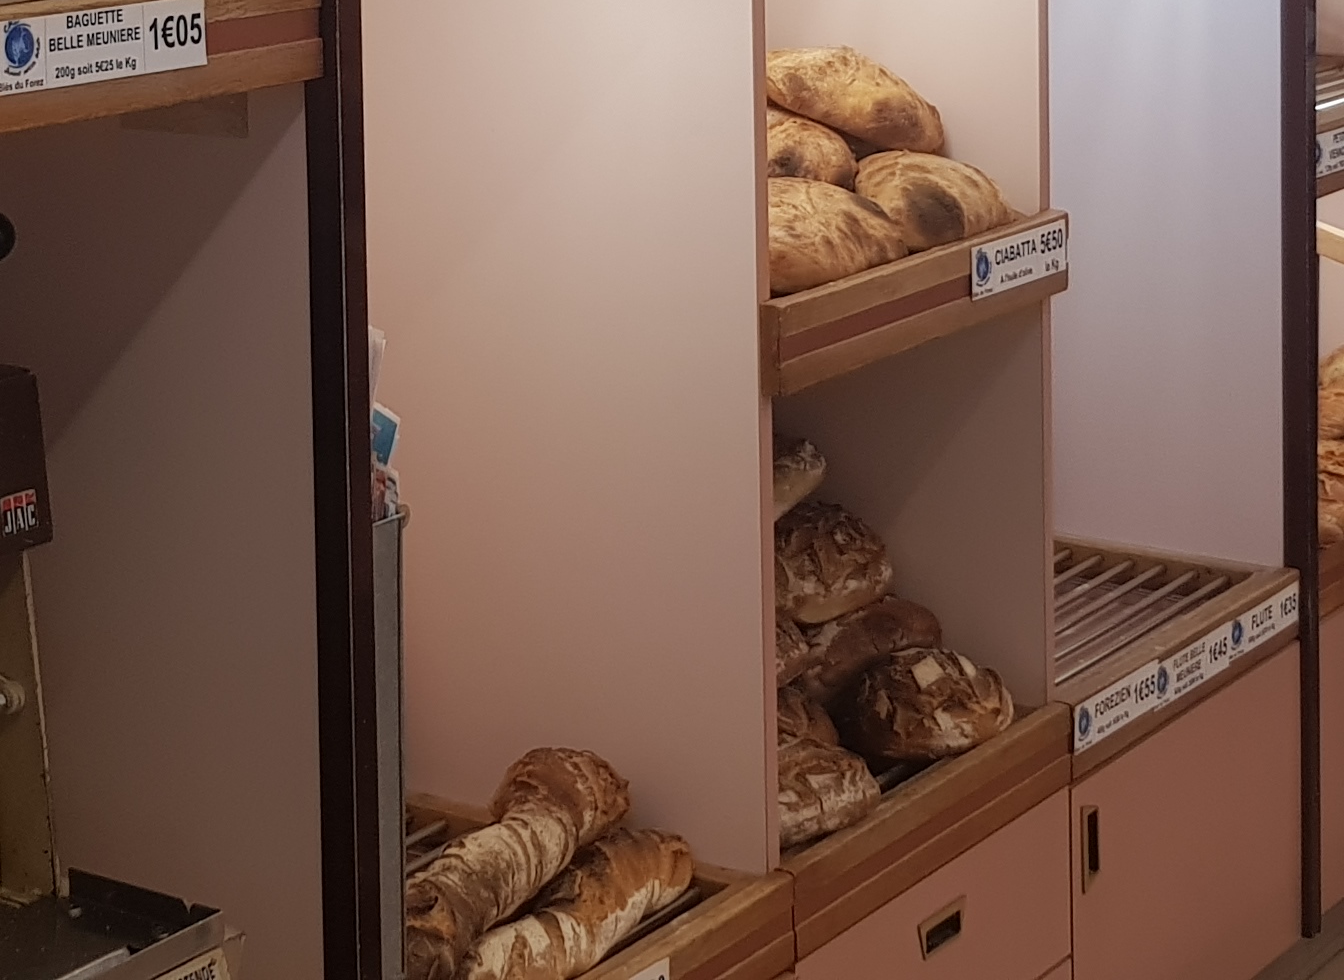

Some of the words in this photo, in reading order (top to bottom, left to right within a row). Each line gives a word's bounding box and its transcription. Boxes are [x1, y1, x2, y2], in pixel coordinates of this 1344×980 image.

[67, 9, 123, 29] BAGUETTE
[149, 13, 202, 50] 1€05
[49, 35, 84, 52] BELLE
[87, 27, 141, 47] MEUNIERE
[55, 67, 75, 79] 200g
[77, 63, 93, 75] soit
[125, 57, 137, 70] Kg
[995, 239, 1037, 265] CIABATTA
[1040, 228, 1063, 254] 5€50
[1252, 605, 1272, 630] FLUTE
[1209, 637, 1227, 663] 1€45
[1095, 685, 1131, 718] FOREZIEN
[1134, 674, 1155, 704] 1€55
